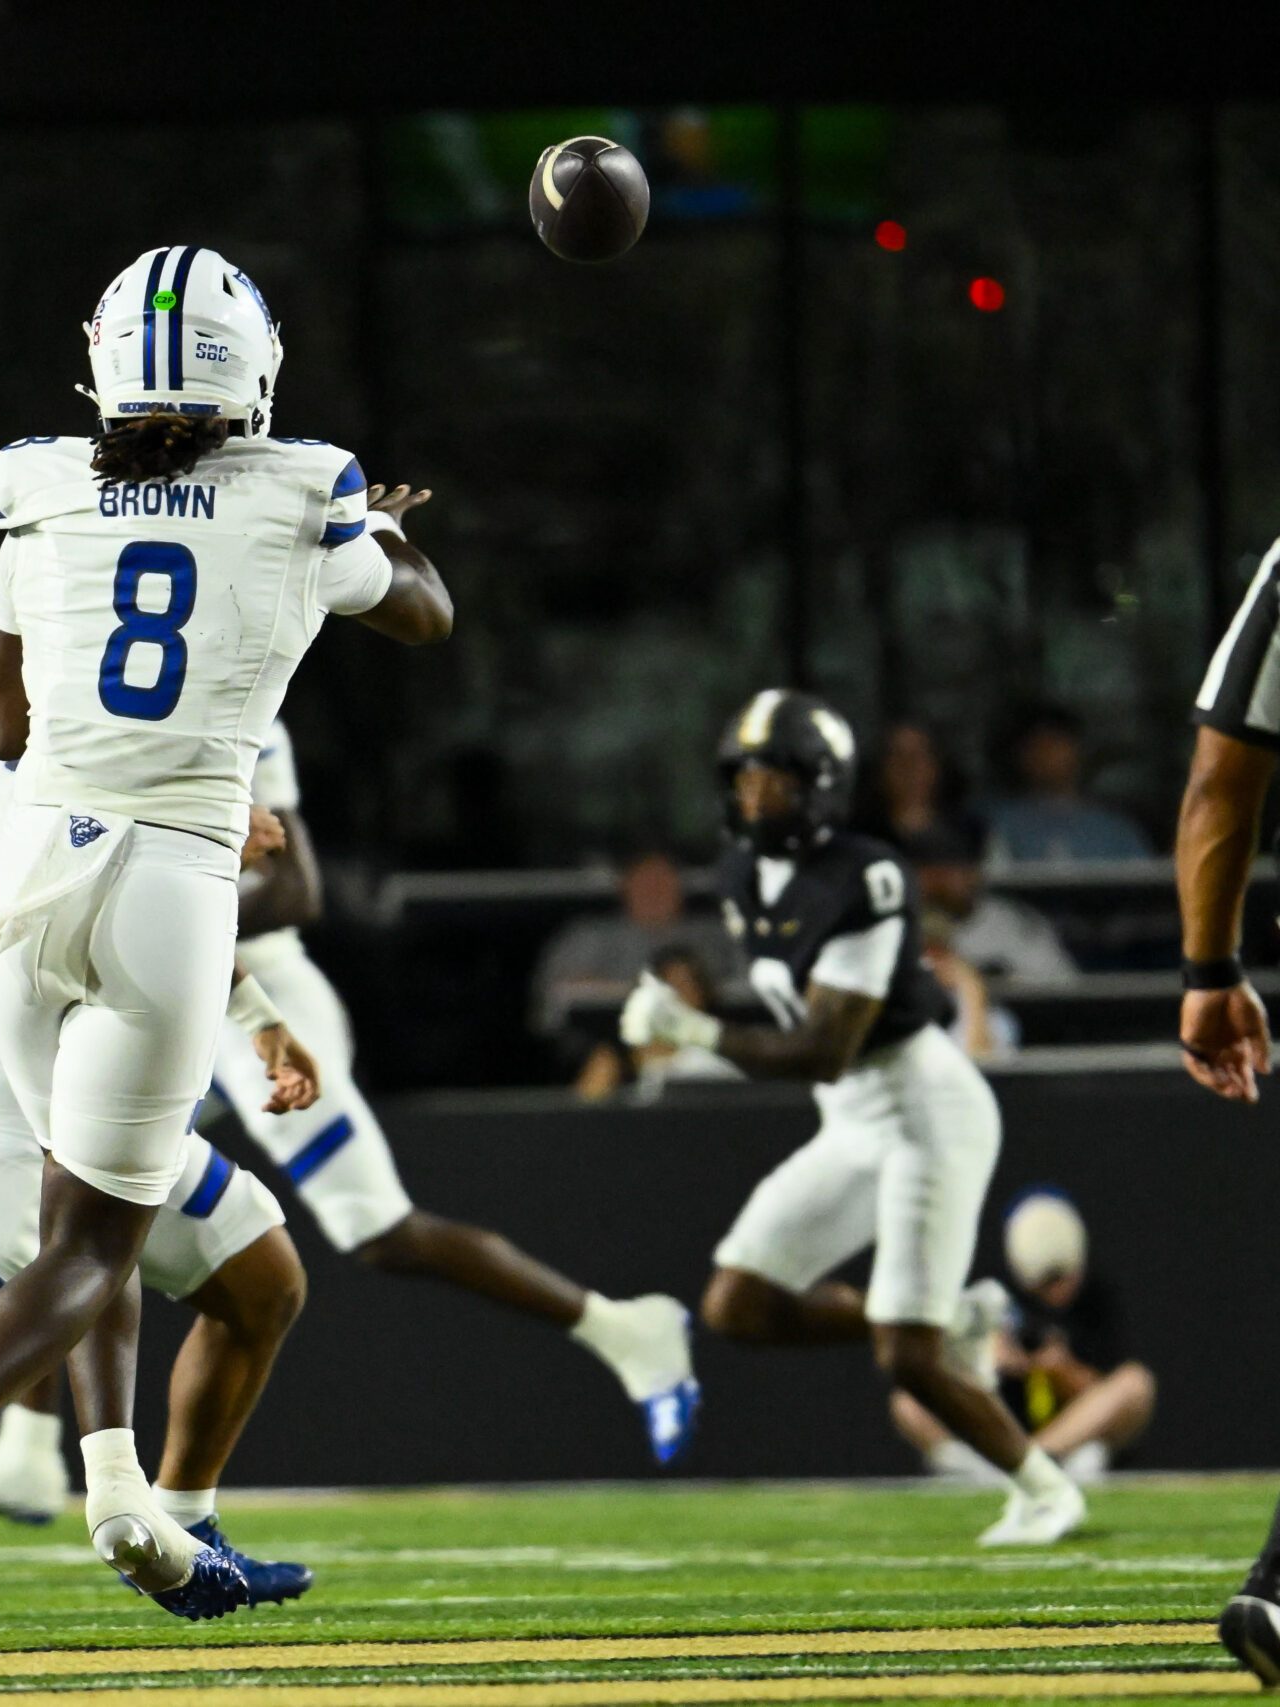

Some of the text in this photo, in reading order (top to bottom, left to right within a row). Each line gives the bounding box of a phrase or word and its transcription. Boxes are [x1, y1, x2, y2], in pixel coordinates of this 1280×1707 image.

[155, 296, 174, 304] C2P
[93, 321, 101, 346] 8
[195, 342, 228, 362] SBC
[99, 483, 216, 520] BROWN
[98, 541, 197, 721] 8
